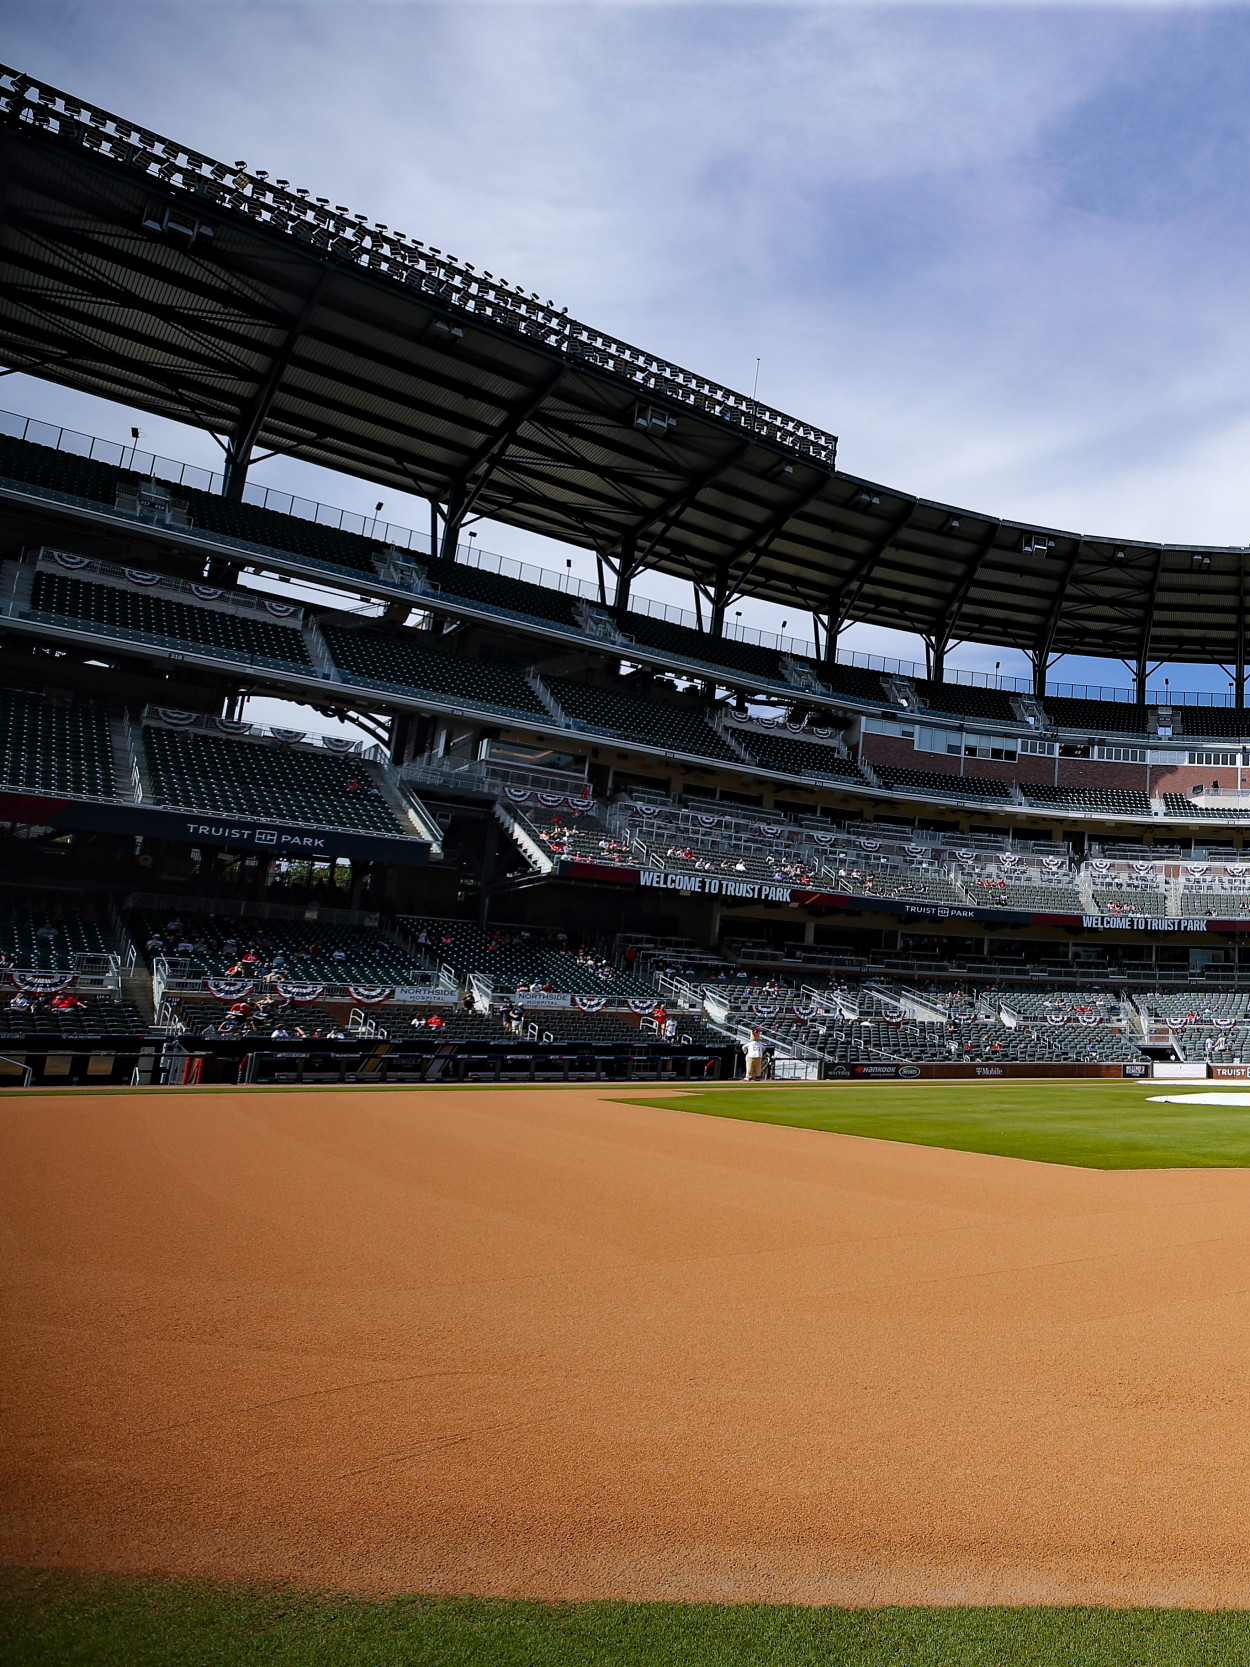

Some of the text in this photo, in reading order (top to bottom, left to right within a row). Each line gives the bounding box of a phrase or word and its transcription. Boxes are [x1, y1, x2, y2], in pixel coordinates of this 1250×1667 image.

[187, 823, 326, 848] TRUIST PARK
[640, 870, 792, 903] WELCOME TO TRUIST PARK
[905, 905, 975, 918] TRUIST PARK
[1082, 916, 1208, 932] WELCOME TO TRUIST PARK
[400, 988, 456, 996] NORTHSIDE
[518, 993, 568, 1001] NORTHSIDE
